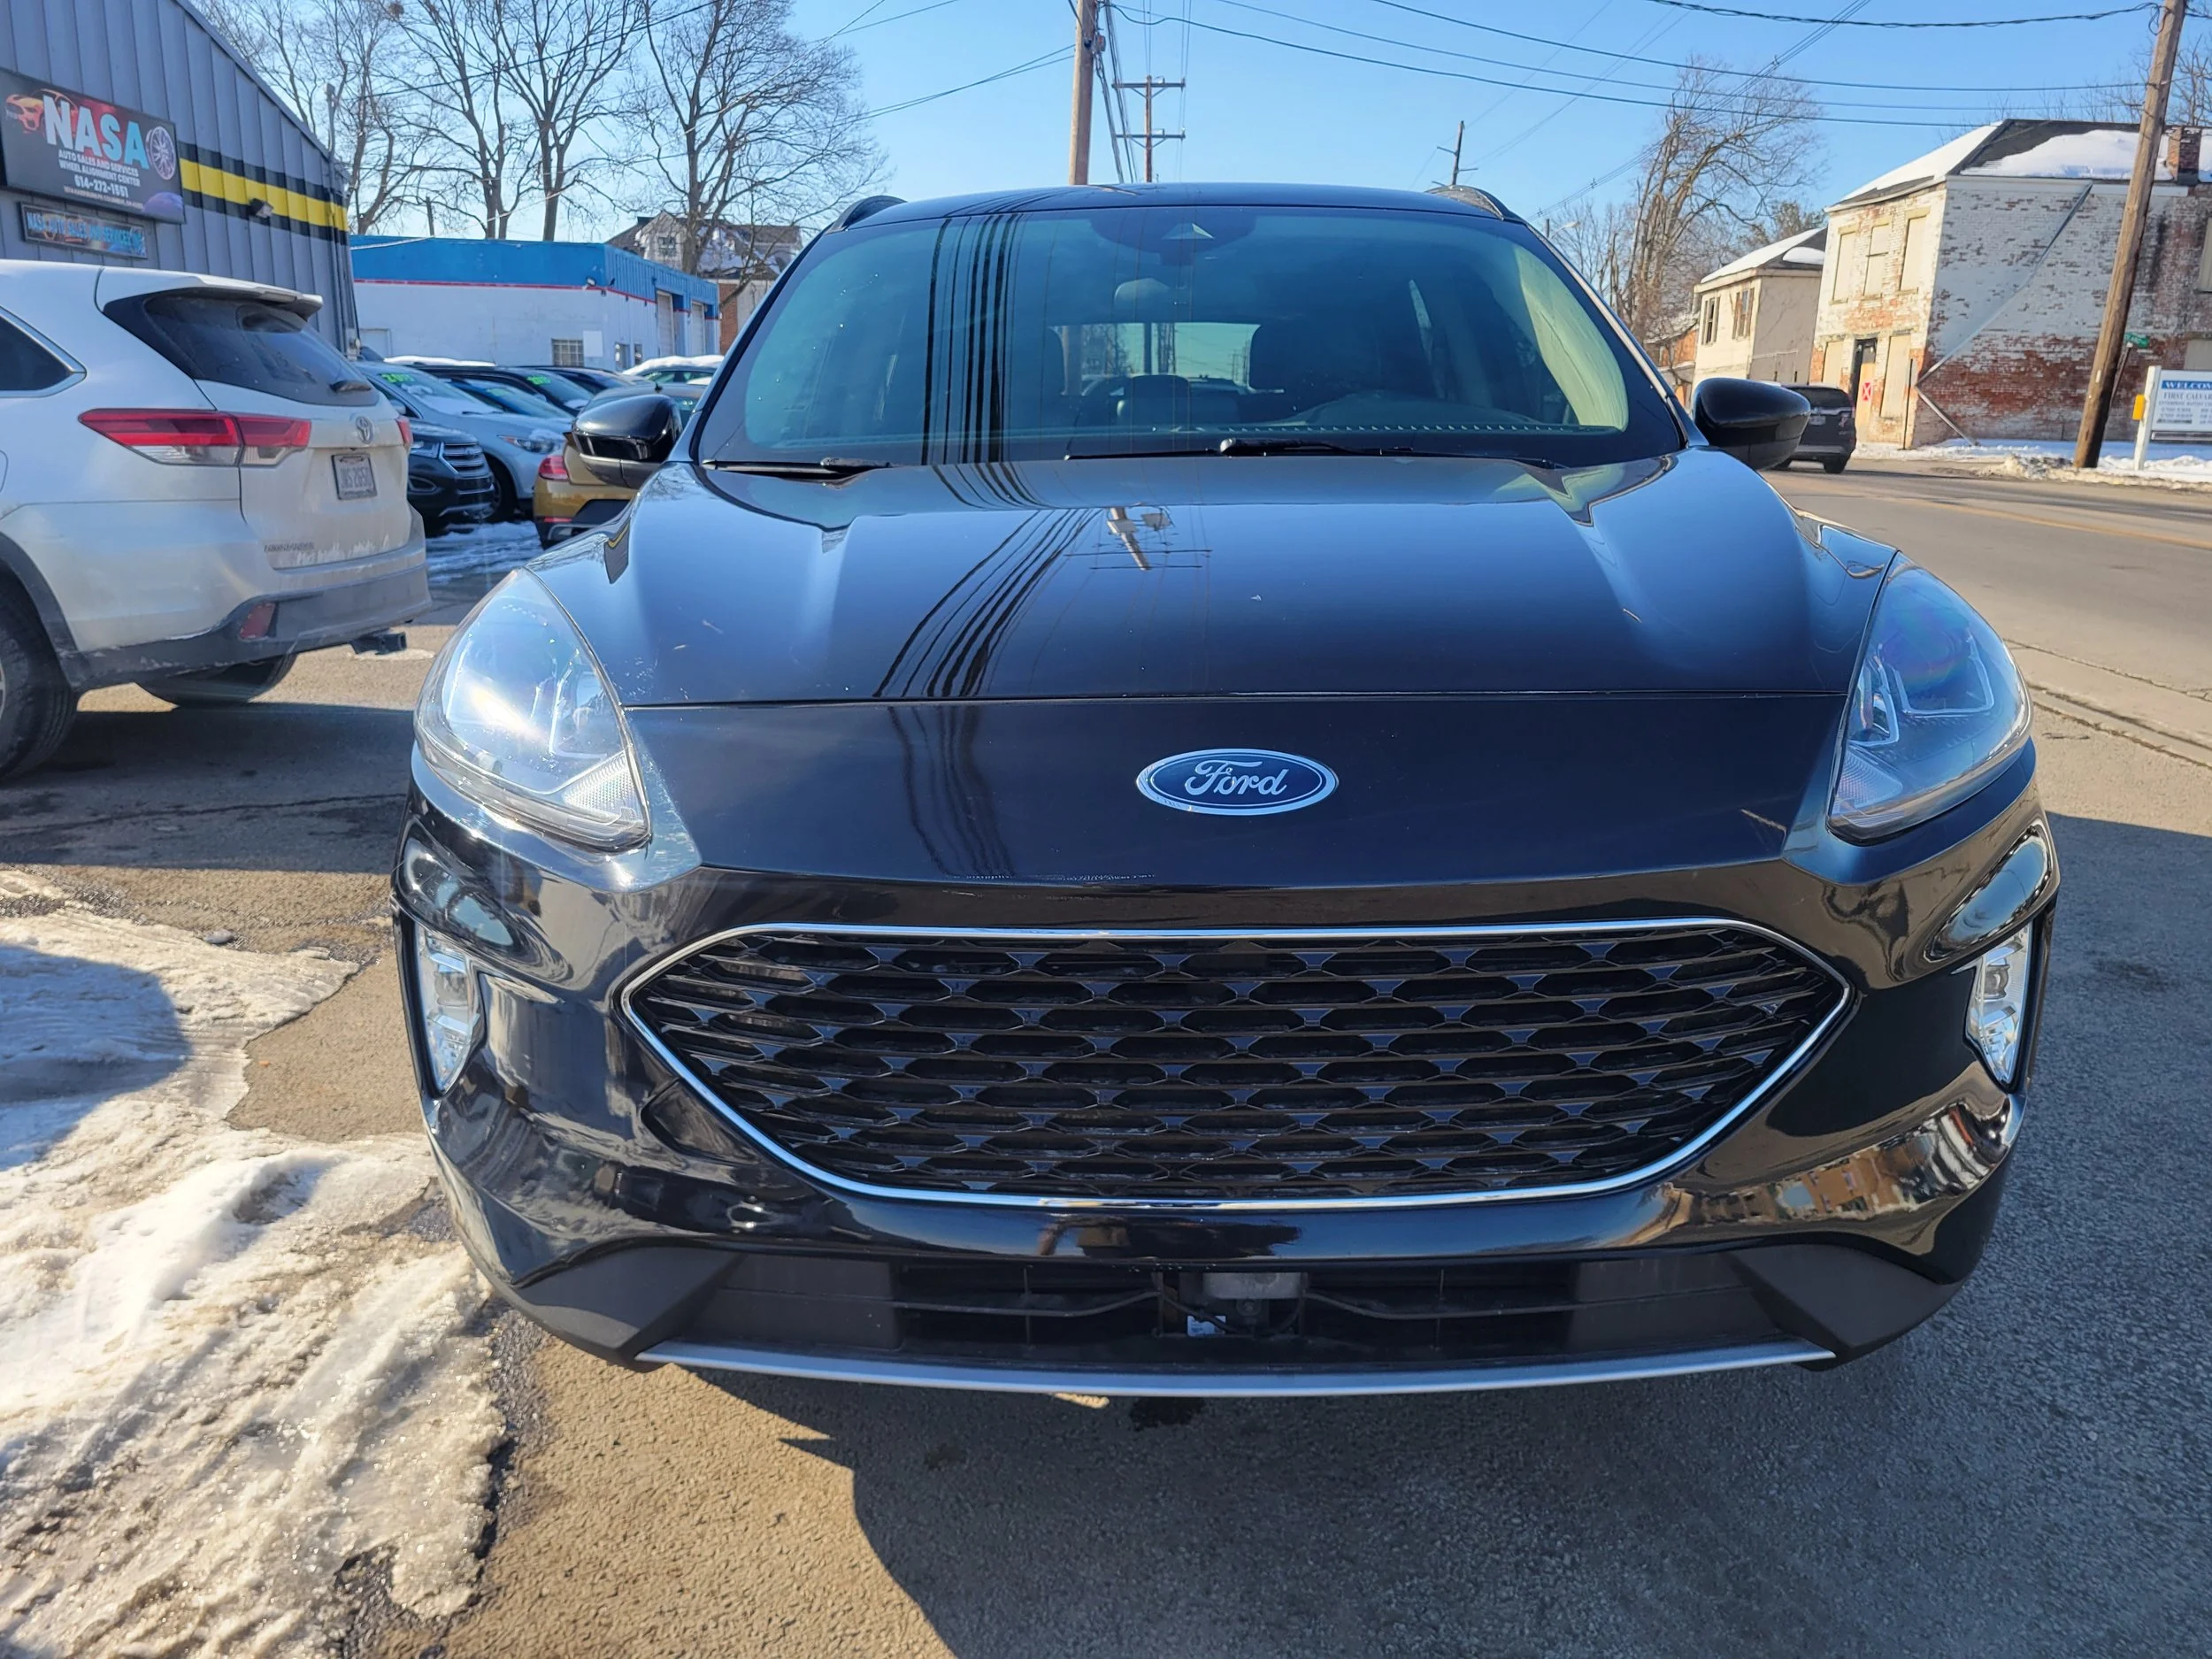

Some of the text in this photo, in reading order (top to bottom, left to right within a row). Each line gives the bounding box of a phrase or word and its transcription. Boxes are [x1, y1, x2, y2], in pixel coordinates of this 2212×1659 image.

[42, 94, 150, 170] NASA
[58, 149, 139, 177] AUTO SALES AND SERVICES
[58, 158, 141, 187] WHEEL ALIGNMENT CENTER
[1185, 759, 1289, 795] Ford
